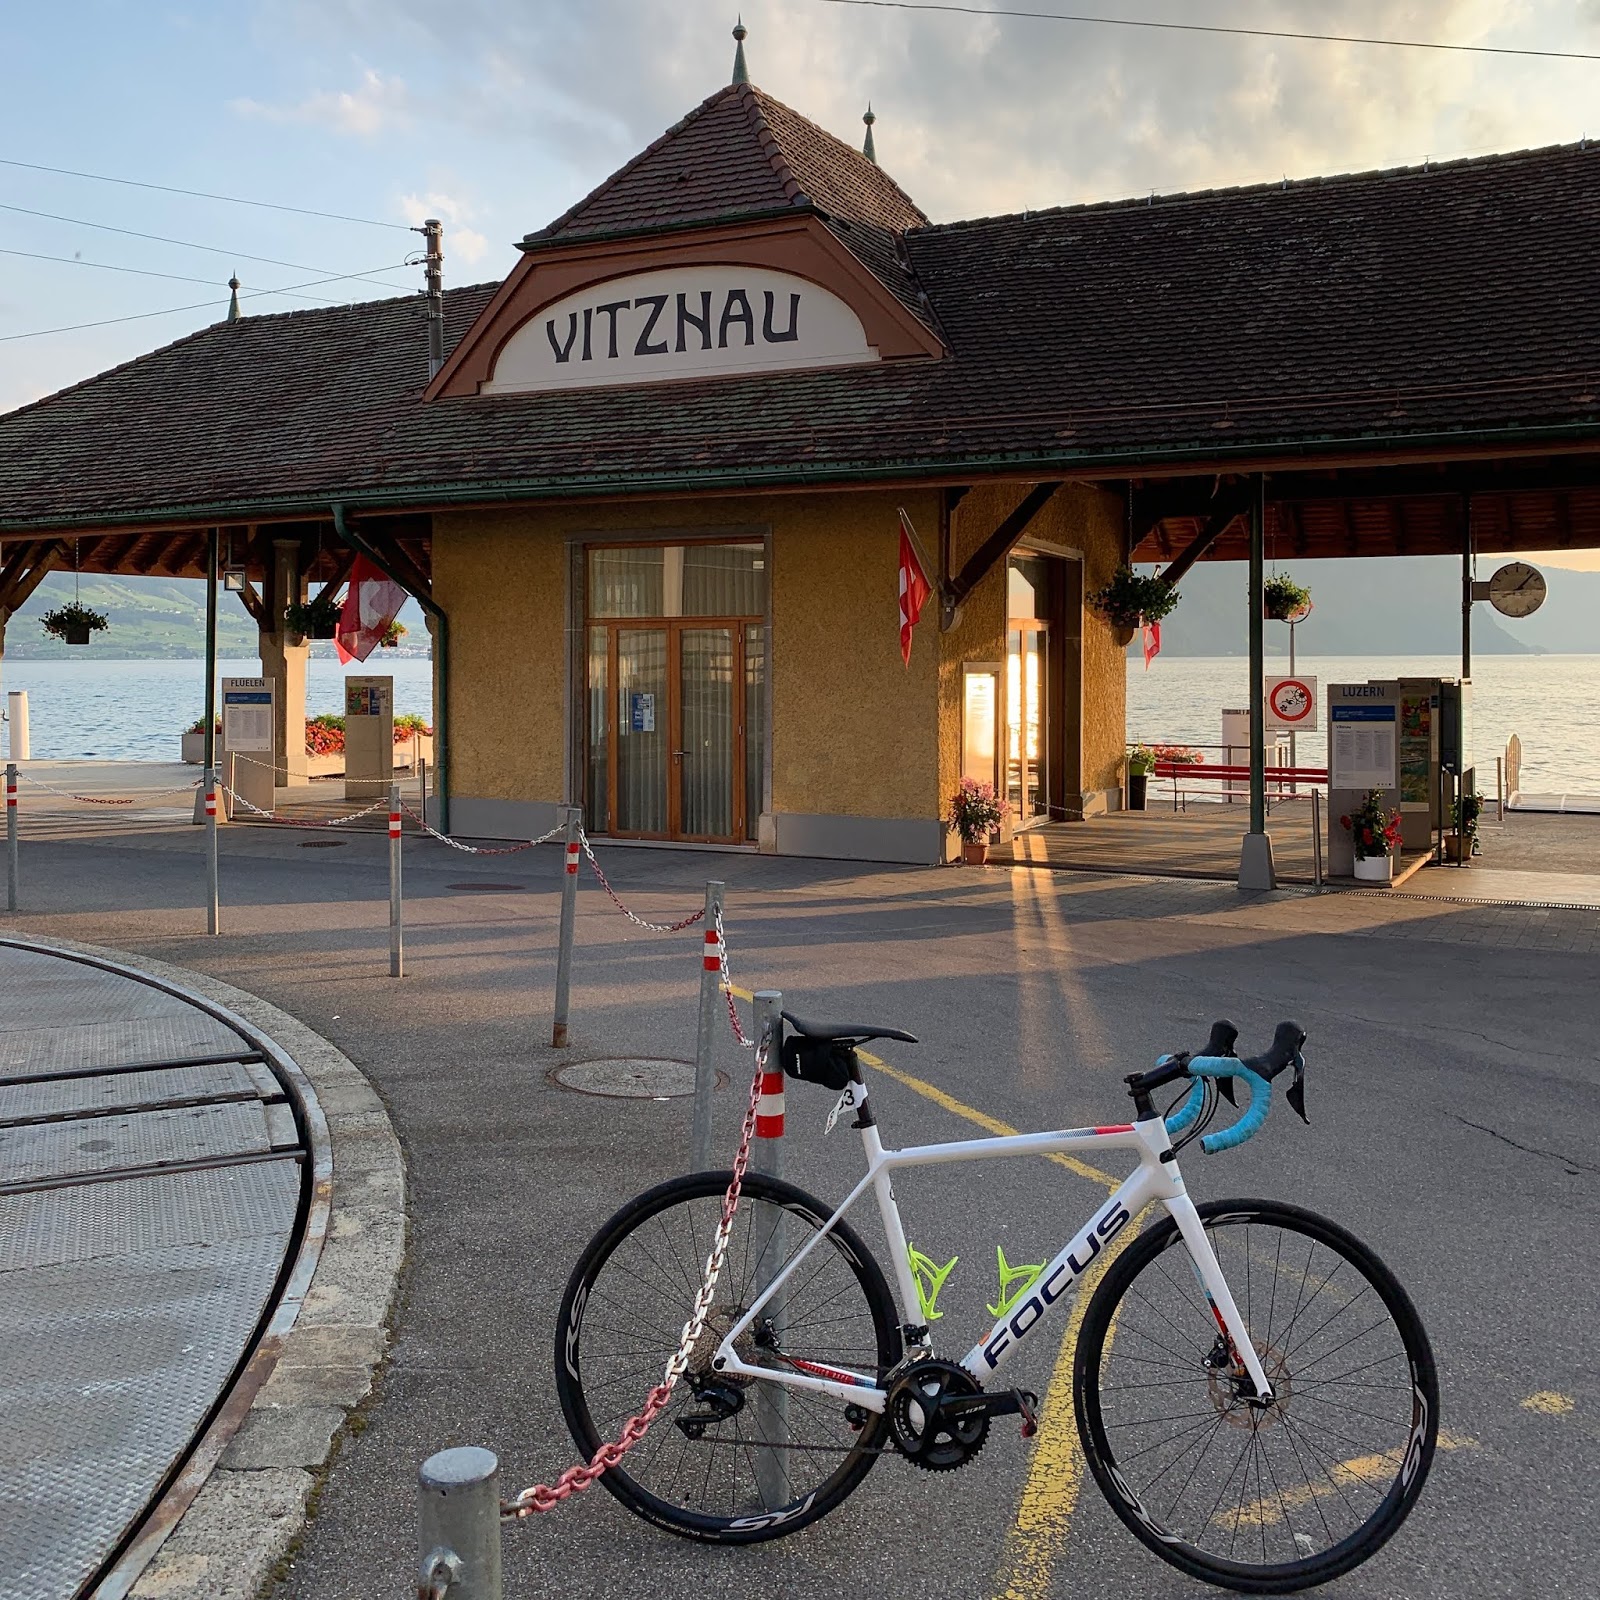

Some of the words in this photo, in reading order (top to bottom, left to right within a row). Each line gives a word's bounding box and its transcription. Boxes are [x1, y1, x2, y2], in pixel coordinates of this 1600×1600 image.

[546, 288, 801, 363] VITZNAU
[1342, 686, 1385, 697] LUZERN
[983, 1201, 1130, 1370] FOCUS
